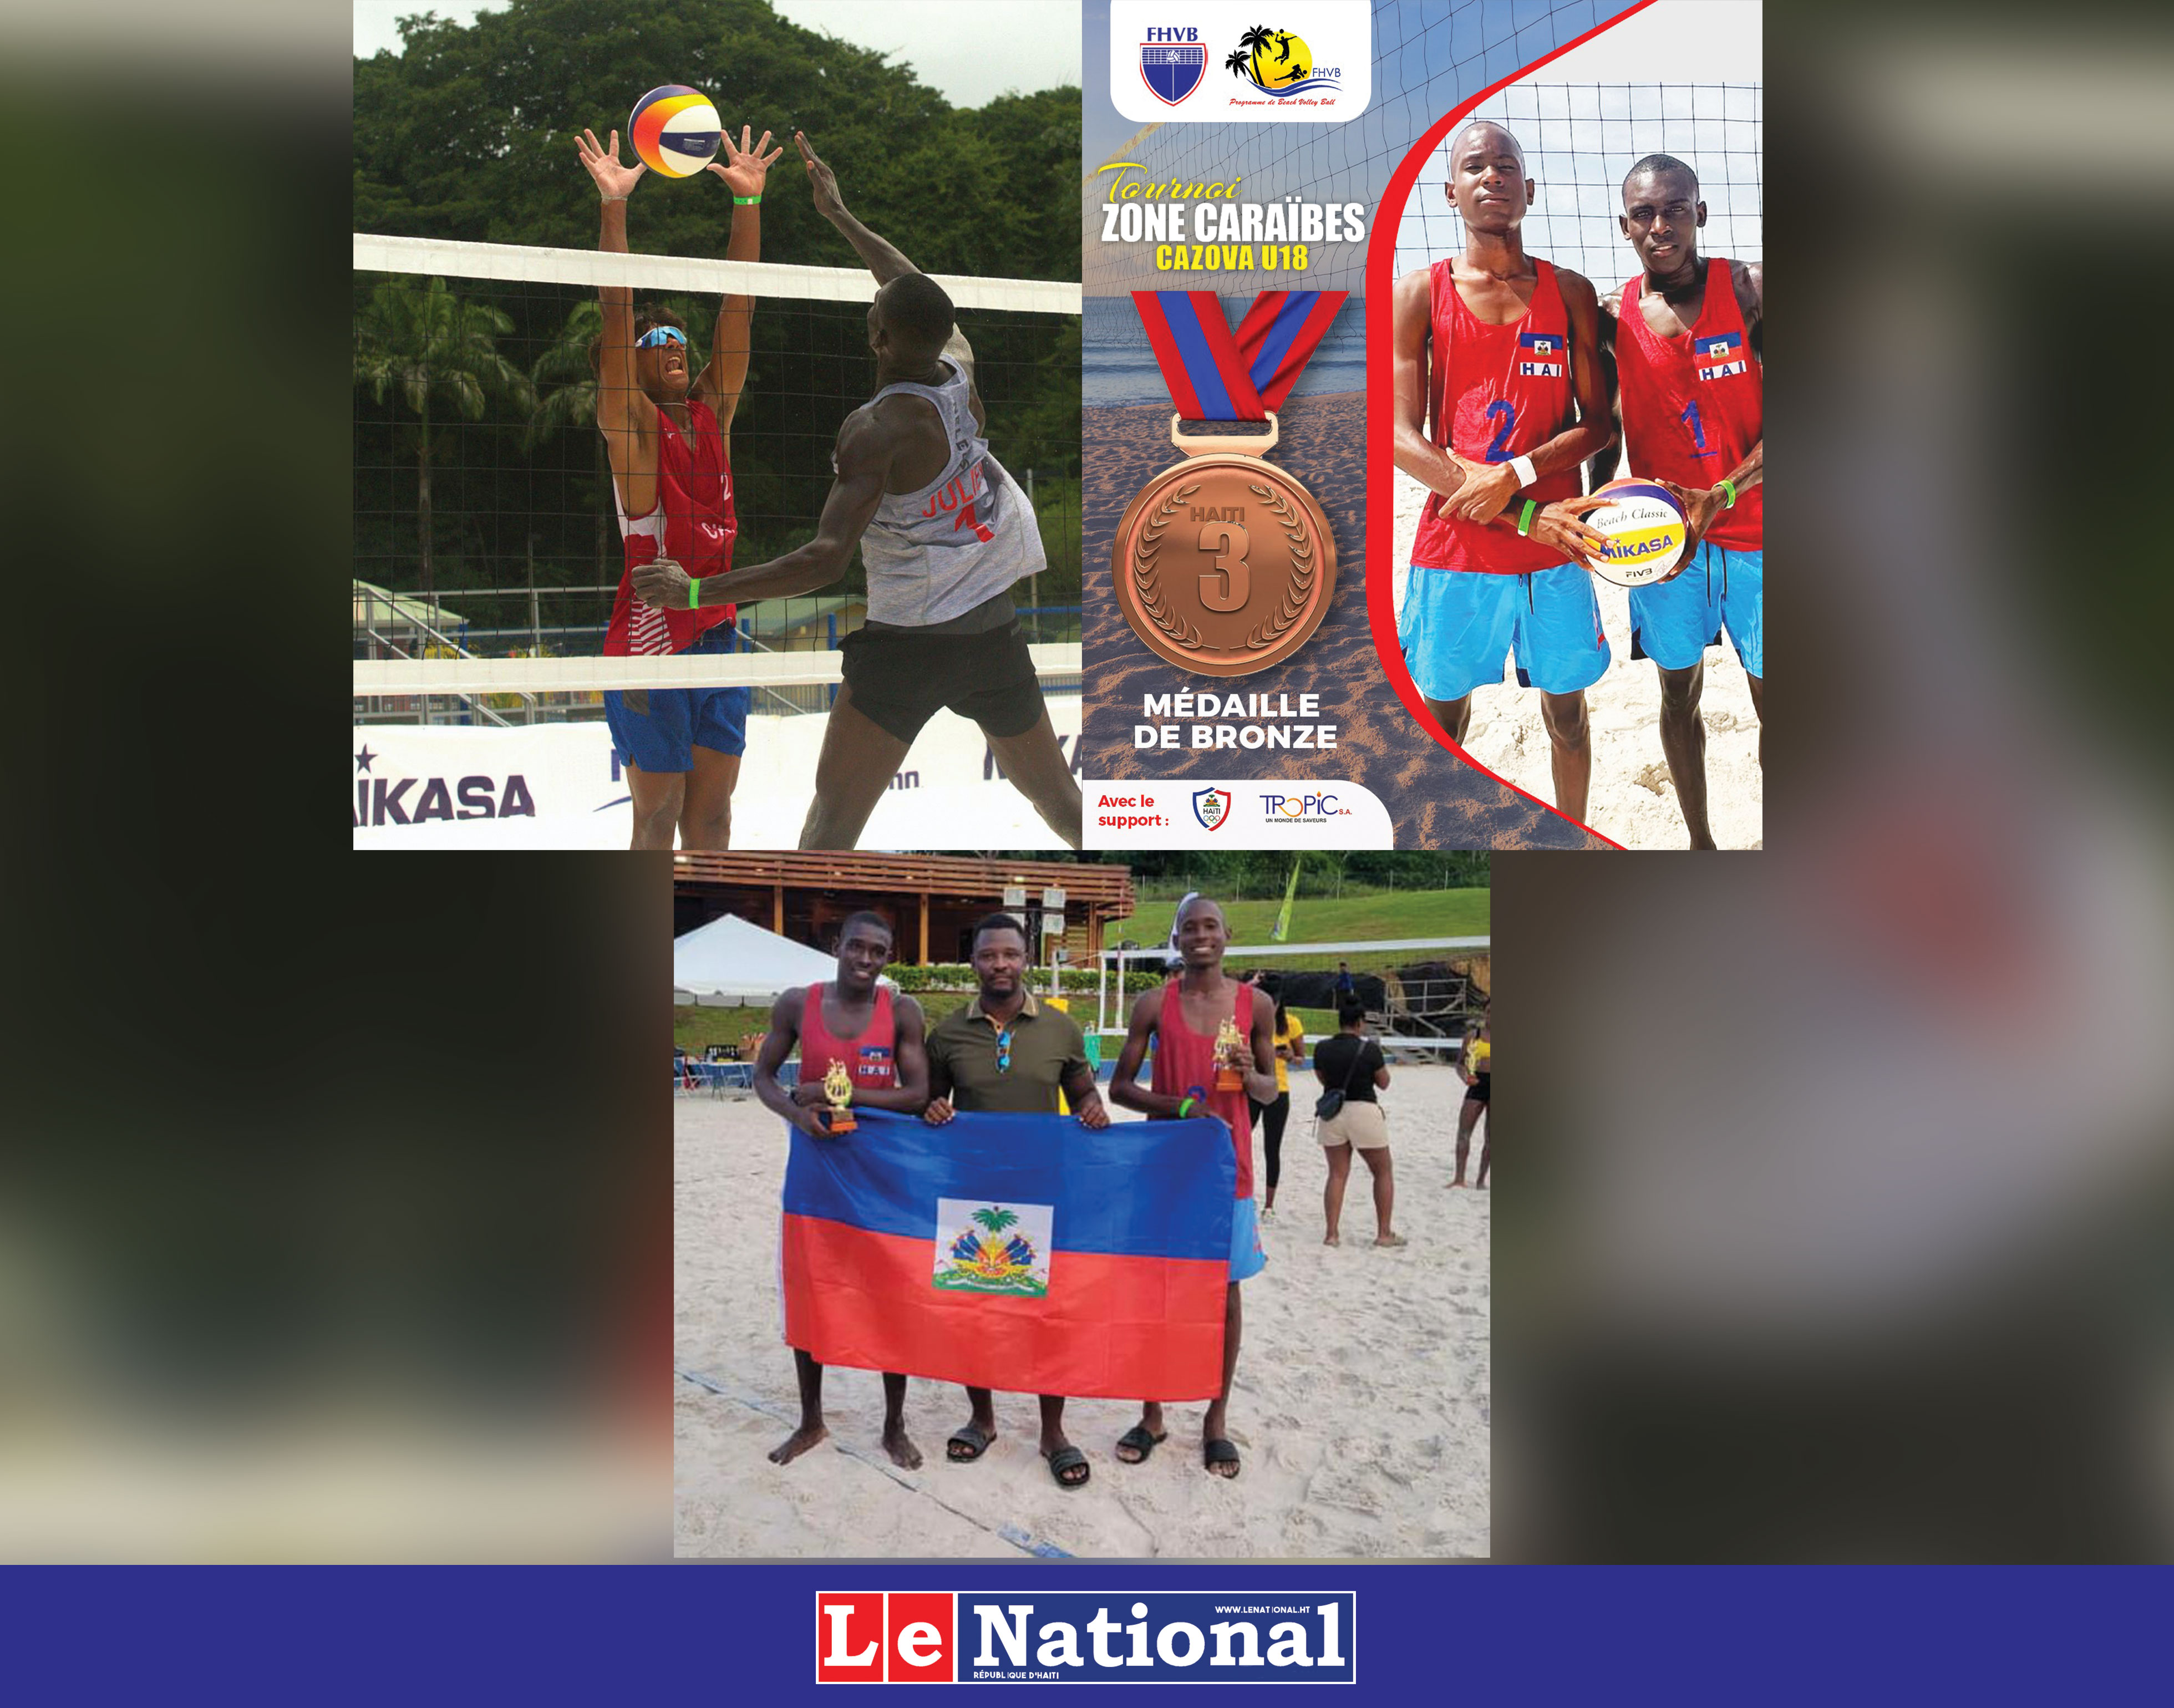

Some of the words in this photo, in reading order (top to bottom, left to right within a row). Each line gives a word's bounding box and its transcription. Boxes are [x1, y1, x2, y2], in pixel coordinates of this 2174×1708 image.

[1522, 363, 1561, 377] HAI
[1701, 360, 1744, 380] HAI
[1486, 400, 1515, 462] 2
[1682, 400, 1717, 459] 1
[1597, 511, 1627, 529] Beach
[1632, 509, 1667, 519] Classic
[1601, 535, 1673, 560] MIKASA
[353, 775, 535, 828] IKASA
